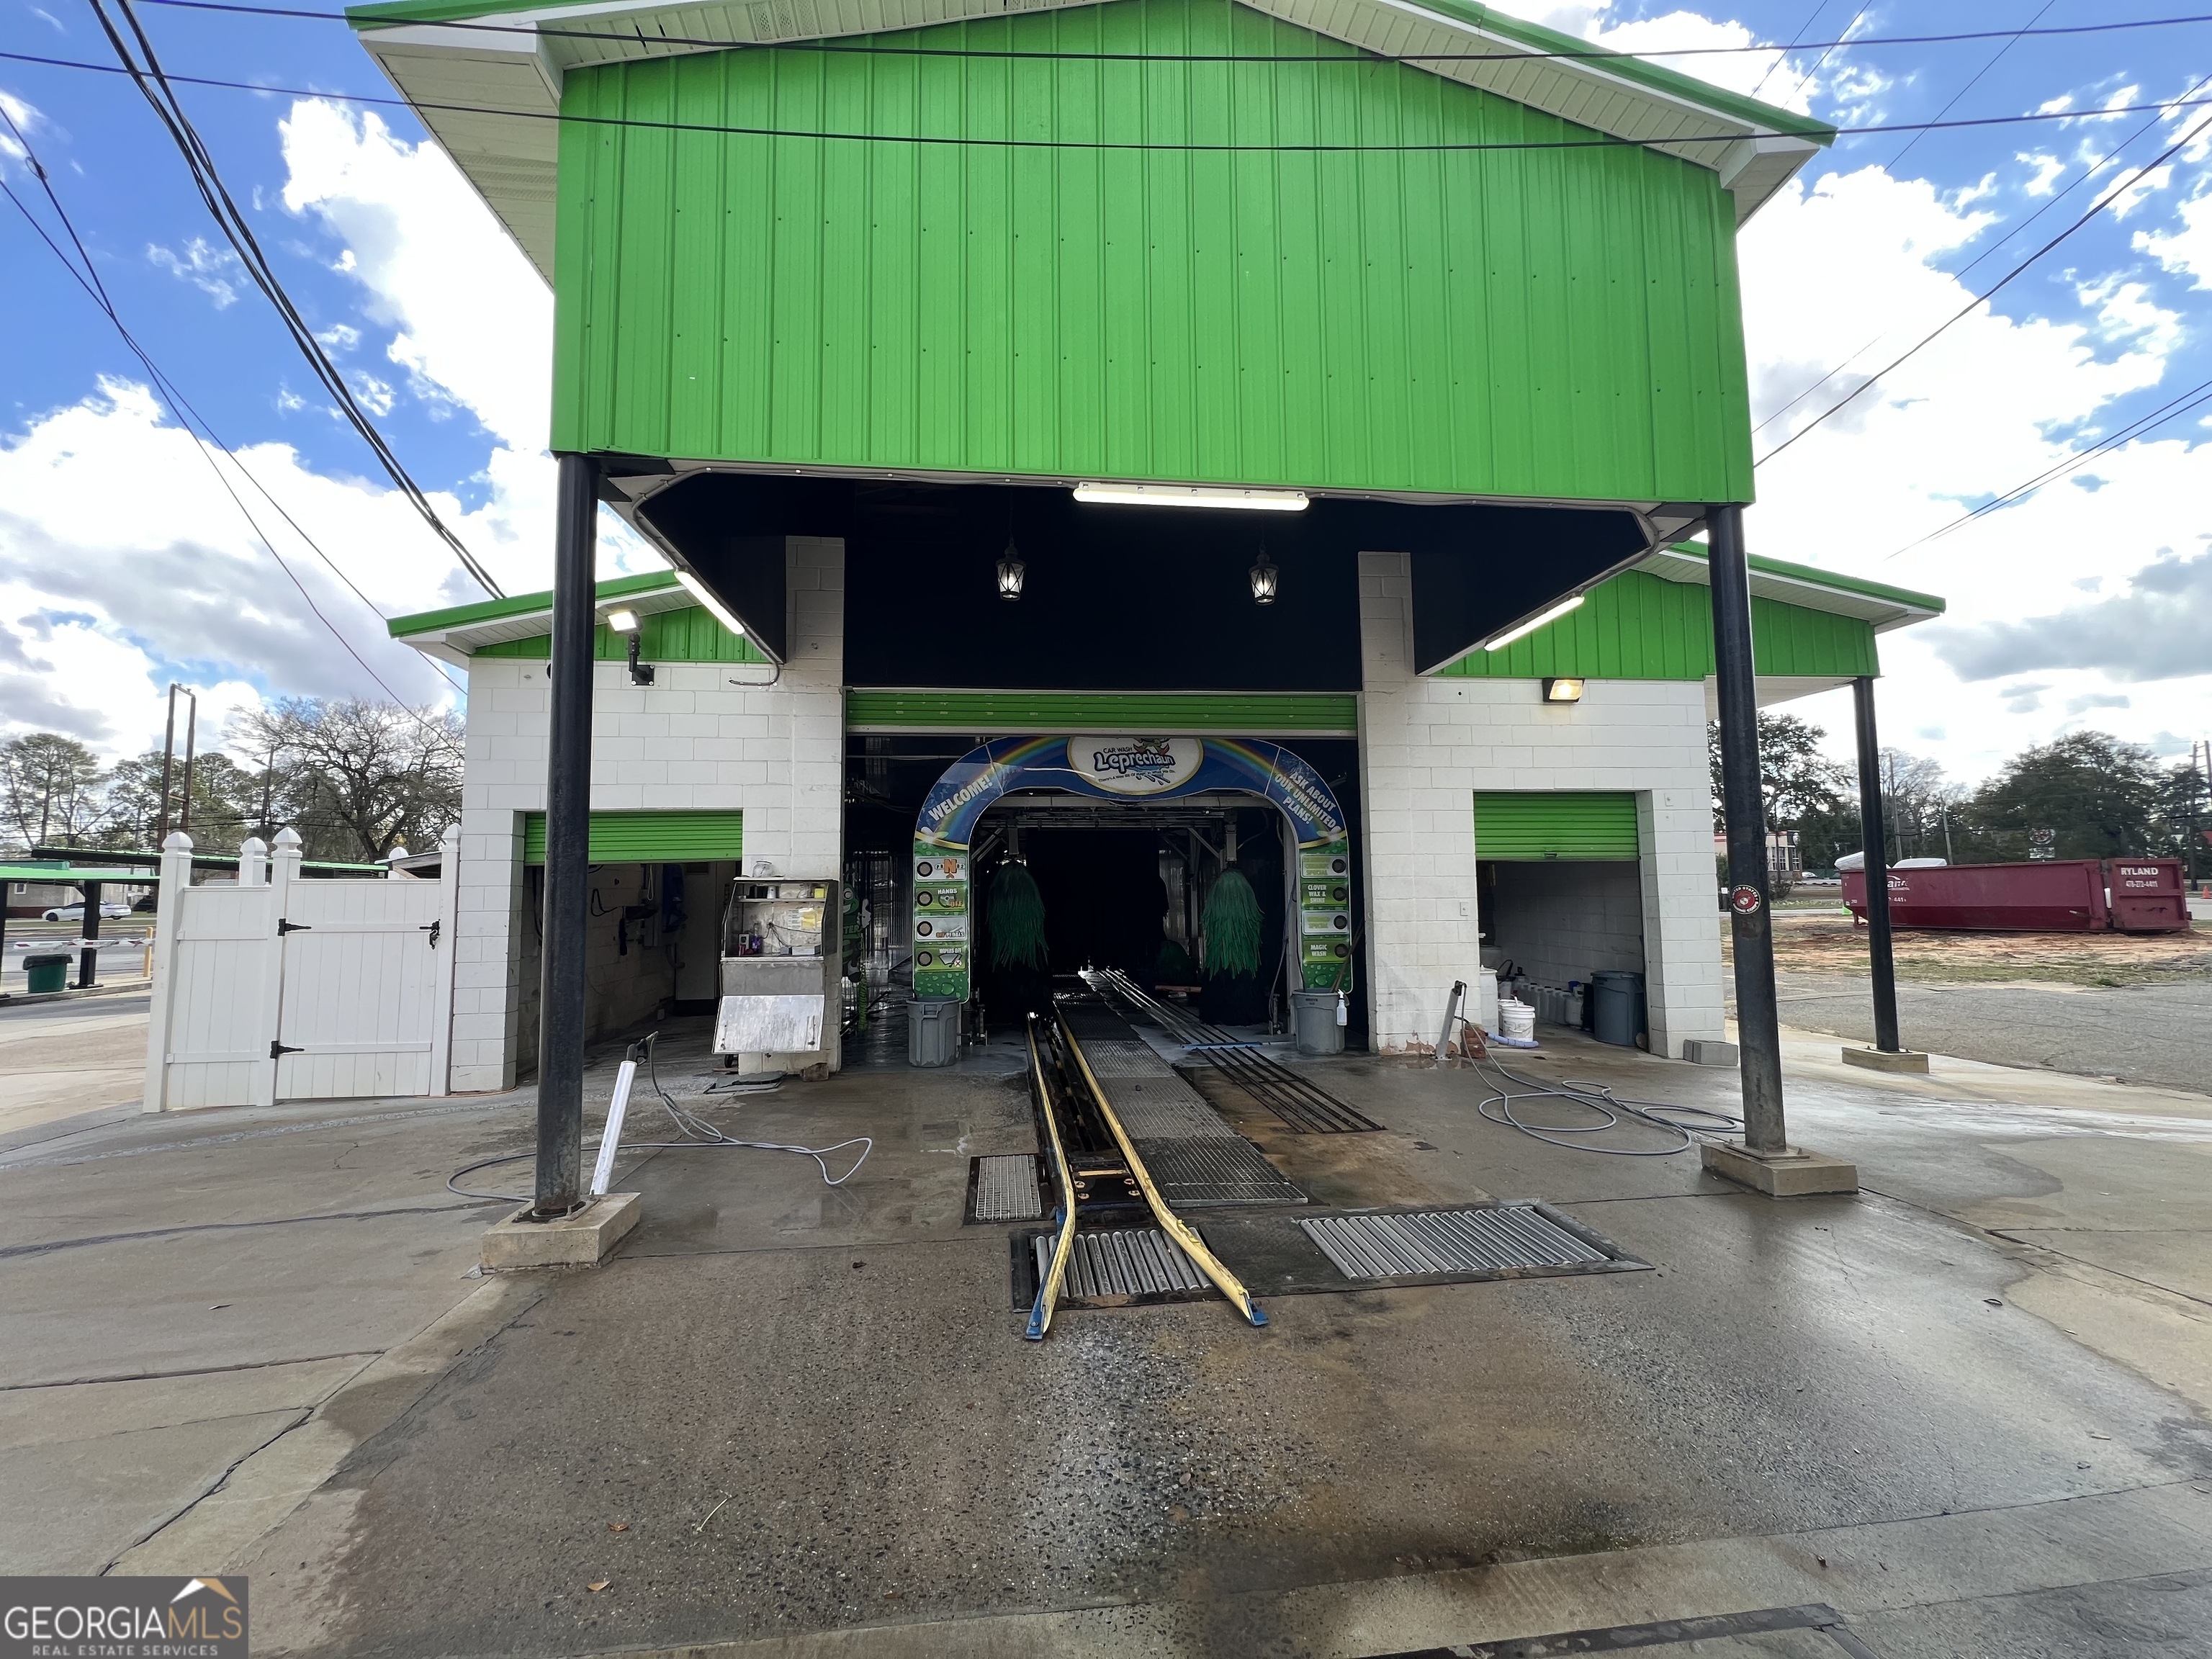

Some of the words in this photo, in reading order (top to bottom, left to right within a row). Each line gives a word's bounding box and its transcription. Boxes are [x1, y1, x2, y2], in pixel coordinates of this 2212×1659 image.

[1094, 750, 1175, 773] Leprechaun
[927, 774, 993, 821] WELCOME!
[1274, 773, 1294, 792] OUR
[1292, 791, 1336, 829] UNLIMITED
[1289, 771, 1309, 789] ASK
[1305, 786, 1336, 811] ABOUT
[1282, 796, 1313, 824] PLANS!
[943, 859, 957, 873] N
[2121, 867, 2159, 876] RYLAND
[1743, 886, 1758, 898] STATES
[842, 925, 860, 935] TER
